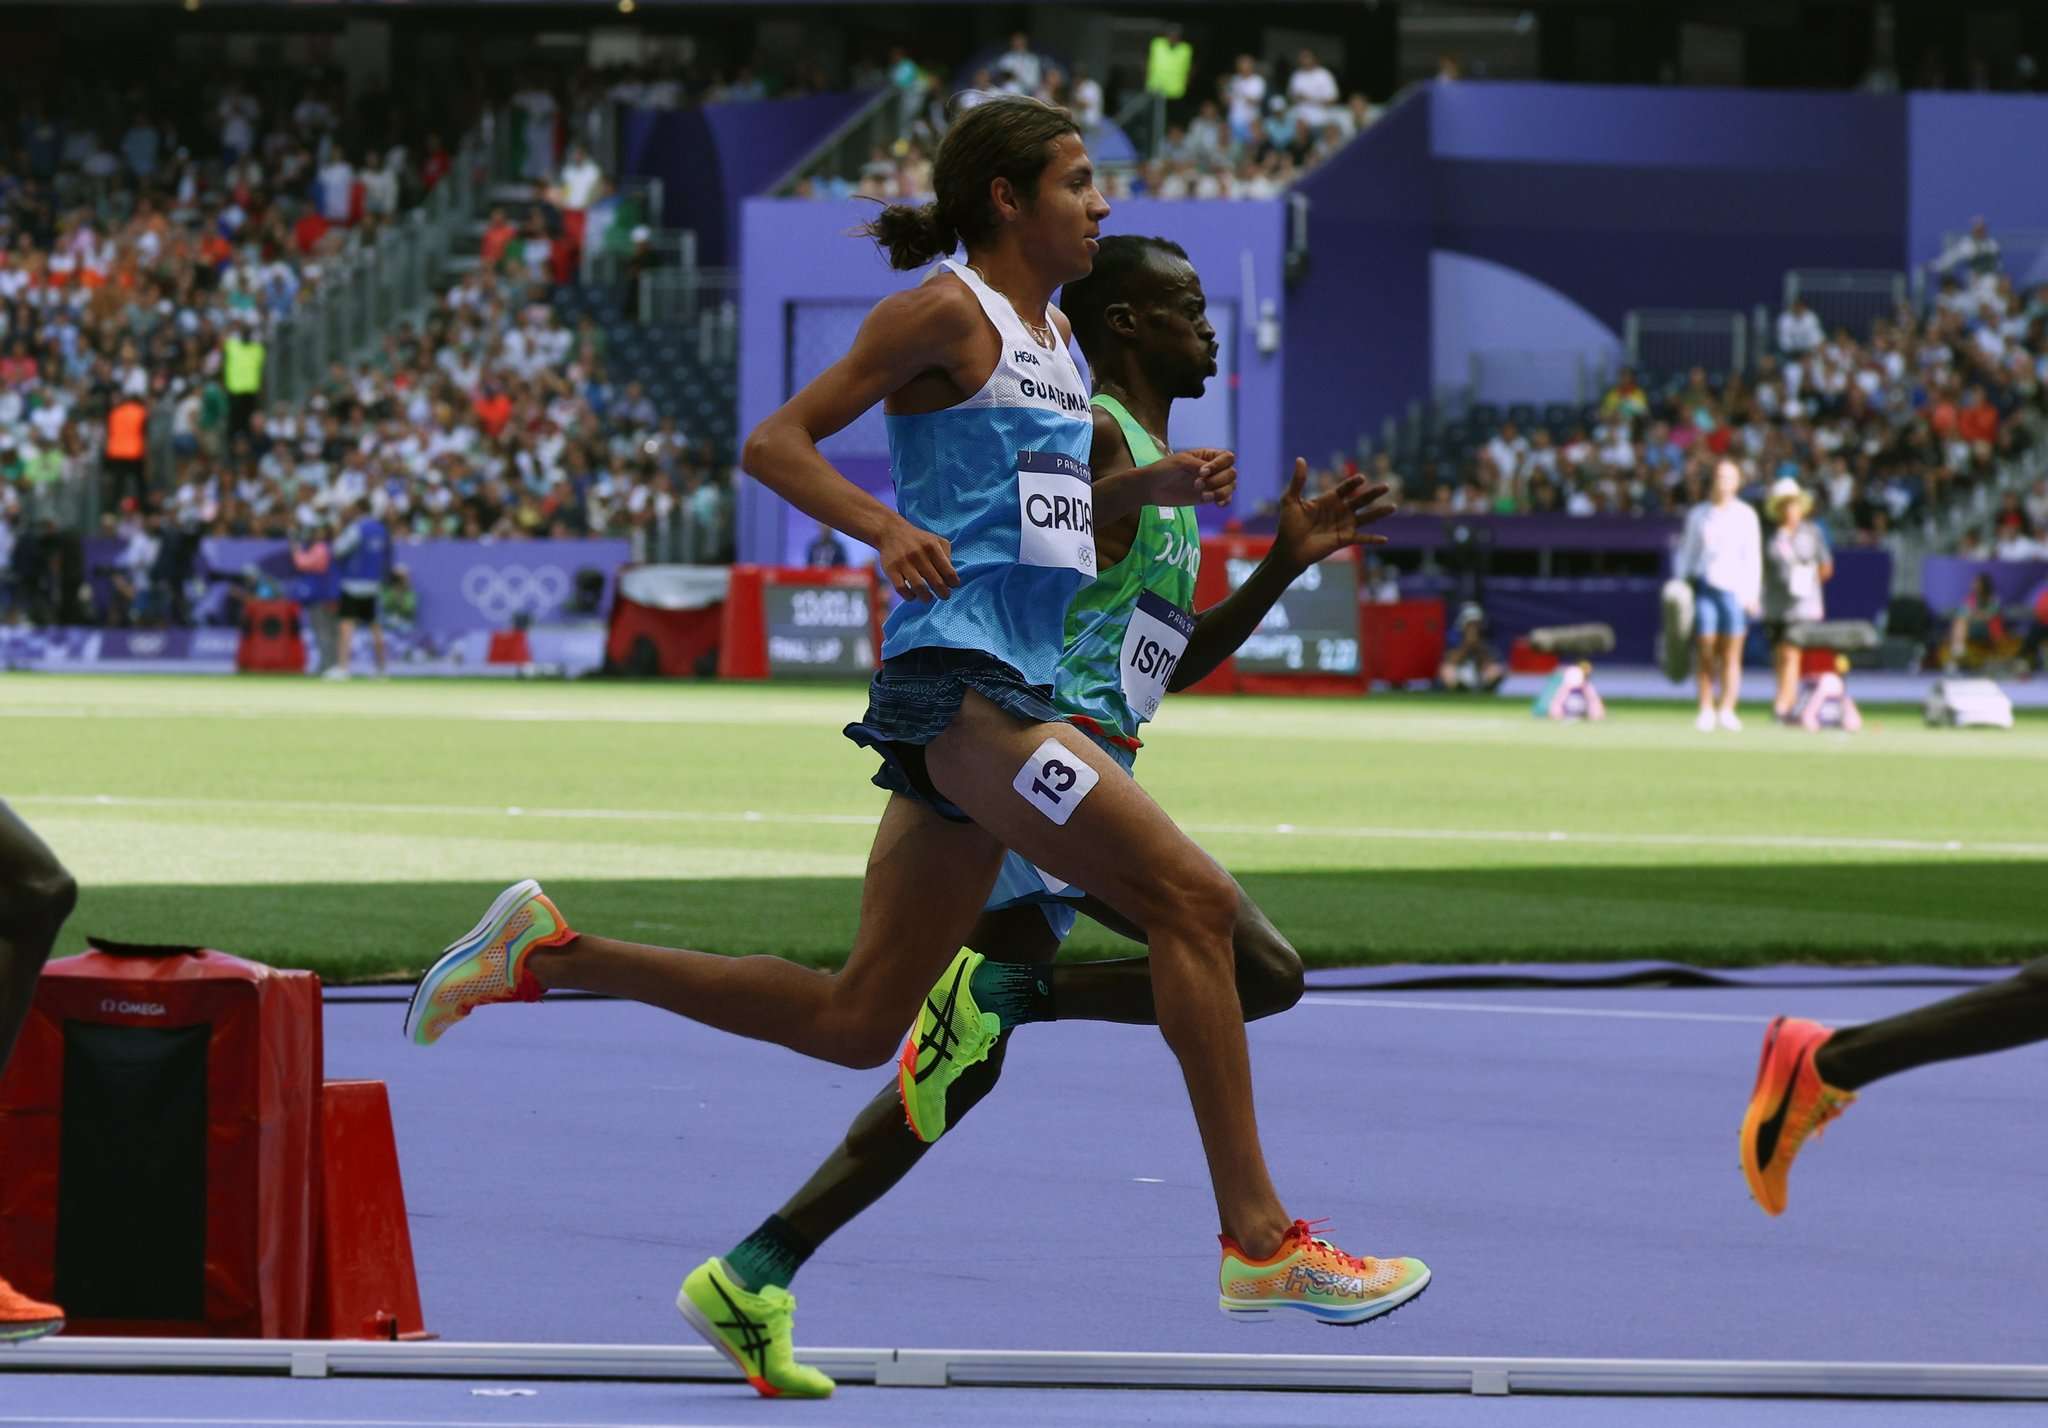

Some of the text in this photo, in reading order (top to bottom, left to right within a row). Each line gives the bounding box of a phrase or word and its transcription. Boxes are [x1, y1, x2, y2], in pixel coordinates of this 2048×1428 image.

[1130, 634, 1178, 689] ISM
[1031, 759, 1077, 805] 13
[1284, 1265, 1364, 1299] HOKA
